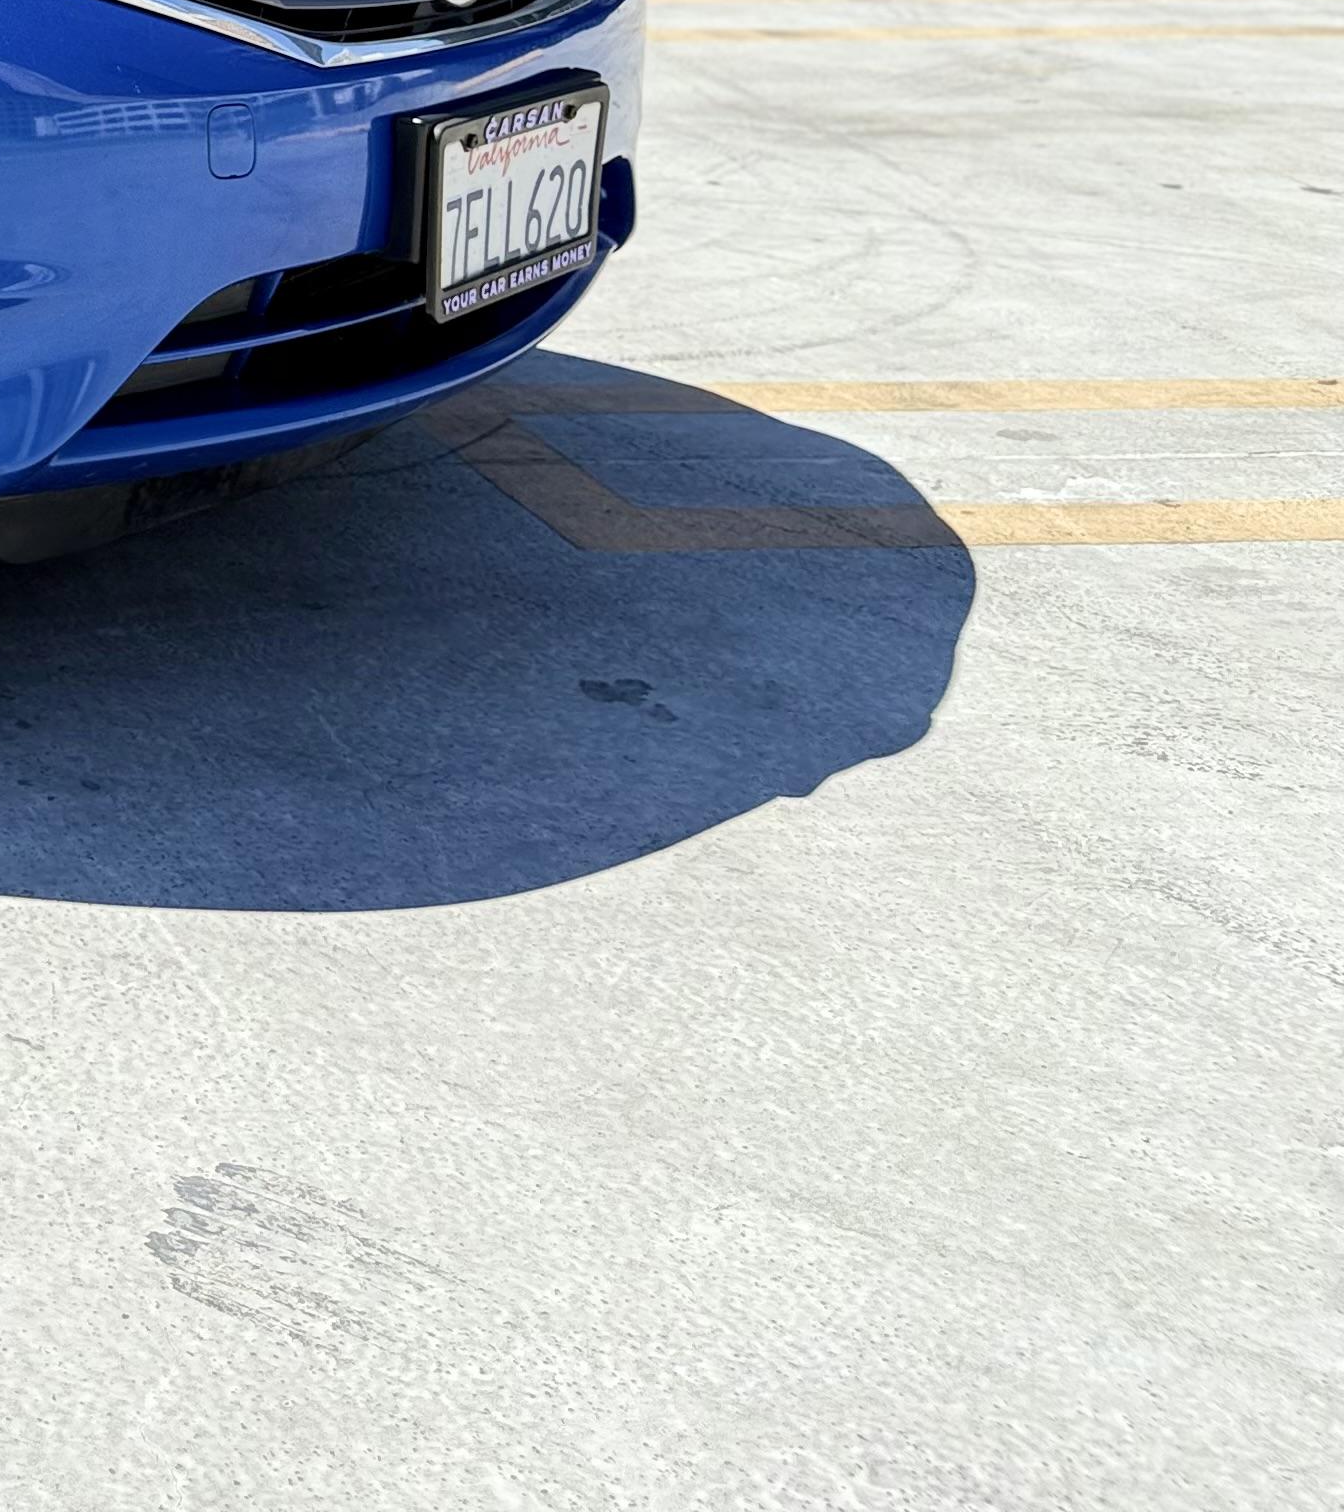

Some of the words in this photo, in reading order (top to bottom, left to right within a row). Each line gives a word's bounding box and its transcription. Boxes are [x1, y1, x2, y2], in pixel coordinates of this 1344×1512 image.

[468, 126, 570, 176] California
[446, 158, 588, 286] 7FLL620
[443, 288, 478, 316] YOUR
[481, 276, 507, 300] CAR
[509, 258, 550, 289] EARNS
[552, 240, 593, 271] MONEY
